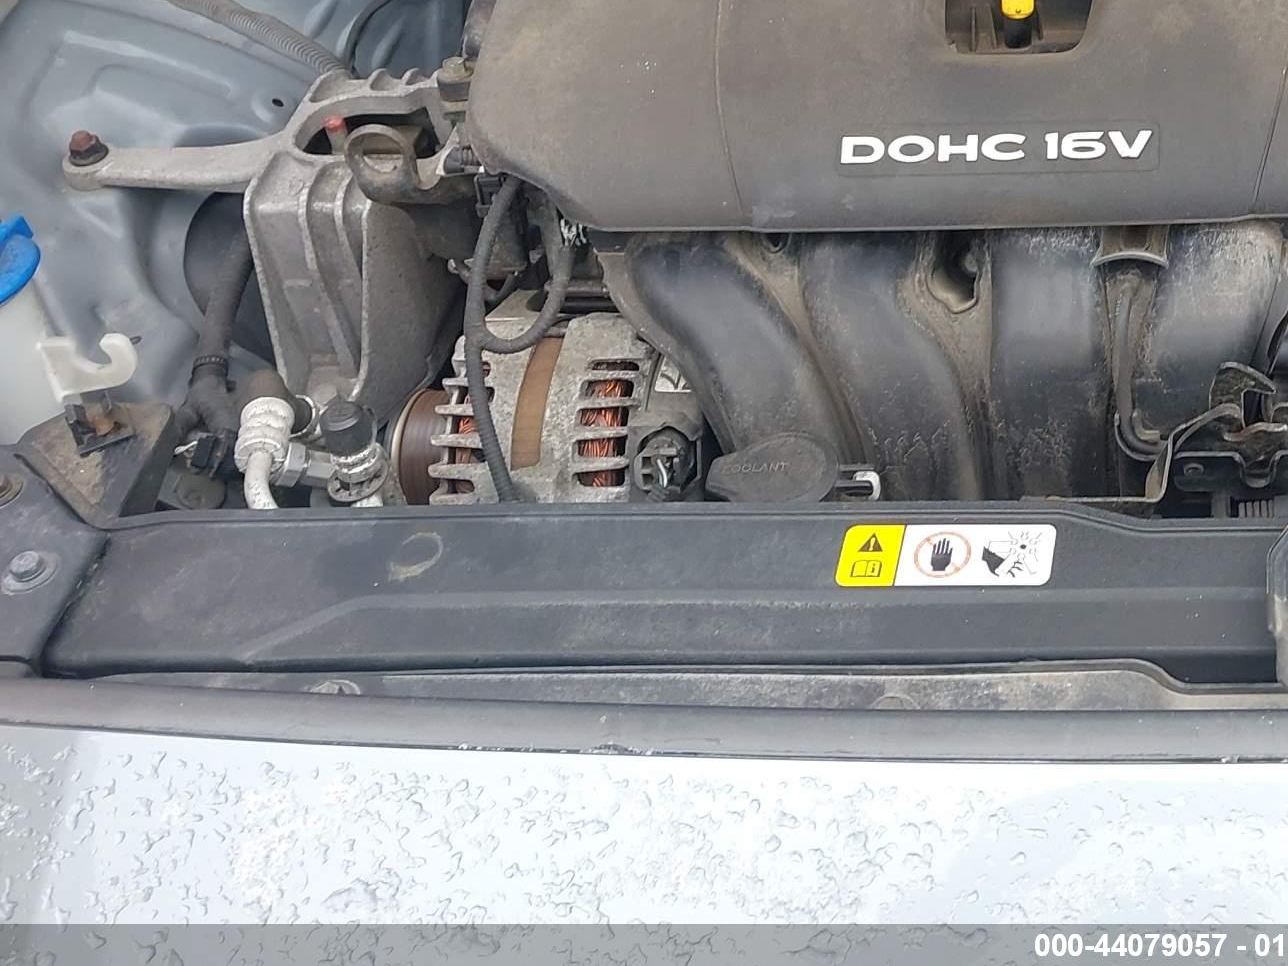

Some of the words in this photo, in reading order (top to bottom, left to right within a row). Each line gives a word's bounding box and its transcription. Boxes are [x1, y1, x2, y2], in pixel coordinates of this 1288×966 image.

[840, 133, 1026, 164] DOHC
[1044, 130, 1153, 160] 16V
[721, 460, 790, 475] COOLANT
